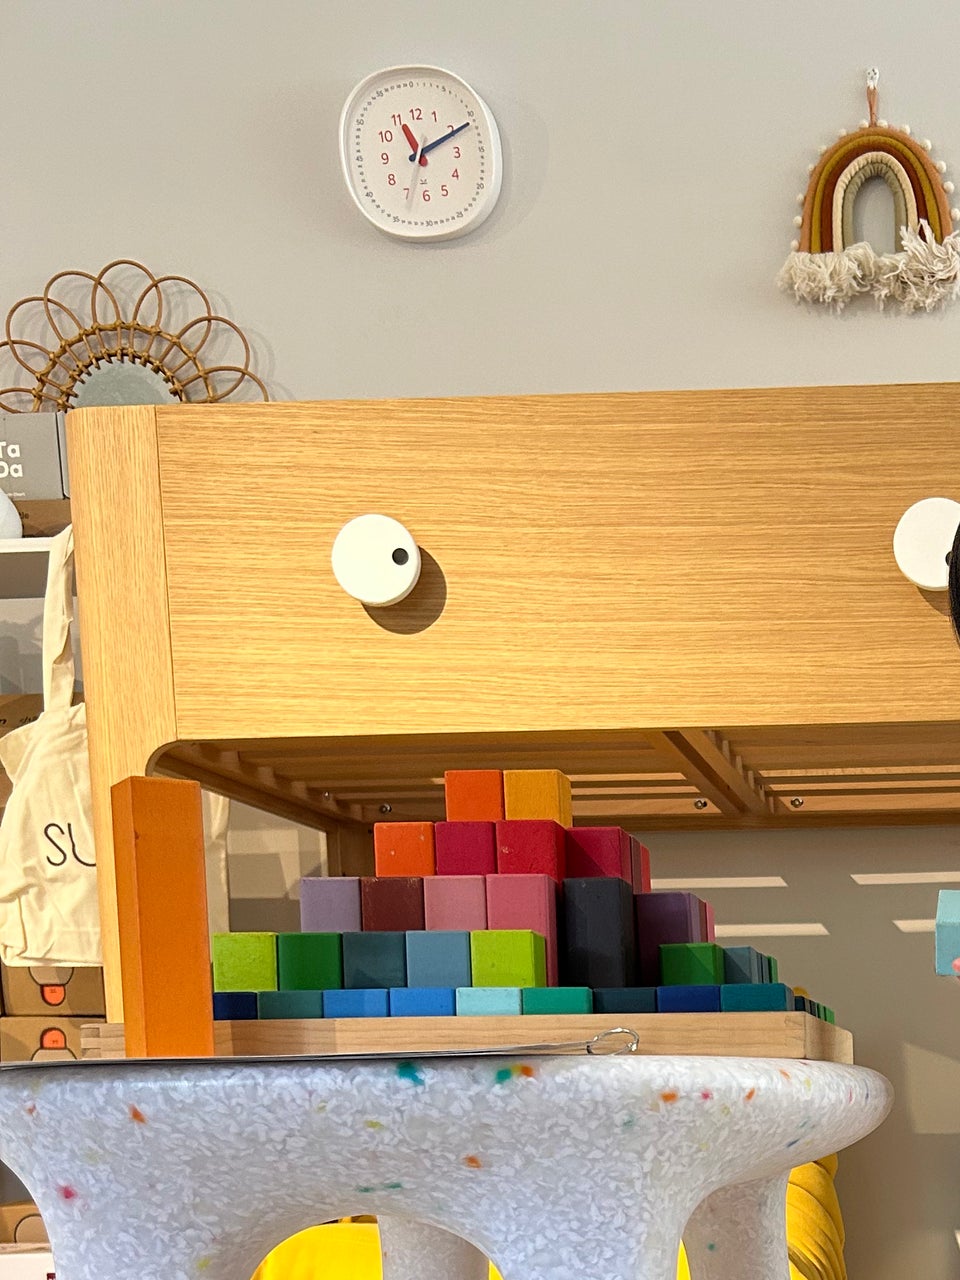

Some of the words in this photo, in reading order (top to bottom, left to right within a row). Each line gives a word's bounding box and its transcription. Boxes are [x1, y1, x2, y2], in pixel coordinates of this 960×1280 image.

[391, 113, 402, 126] 11
[409, 108, 423, 121] 12
[431, 110, 438, 123] 1
[378, 130, 393, 143] 10
[380, 152, 389, 165] 9
[453, 146, 461, 159] 3
[387, 173, 396, 186] 8
[451, 168, 459, 180] 4
[403, 187, 410, 200] 7
[422, 189, 431, 202] 6
[440, 184, 449, 197] 5
